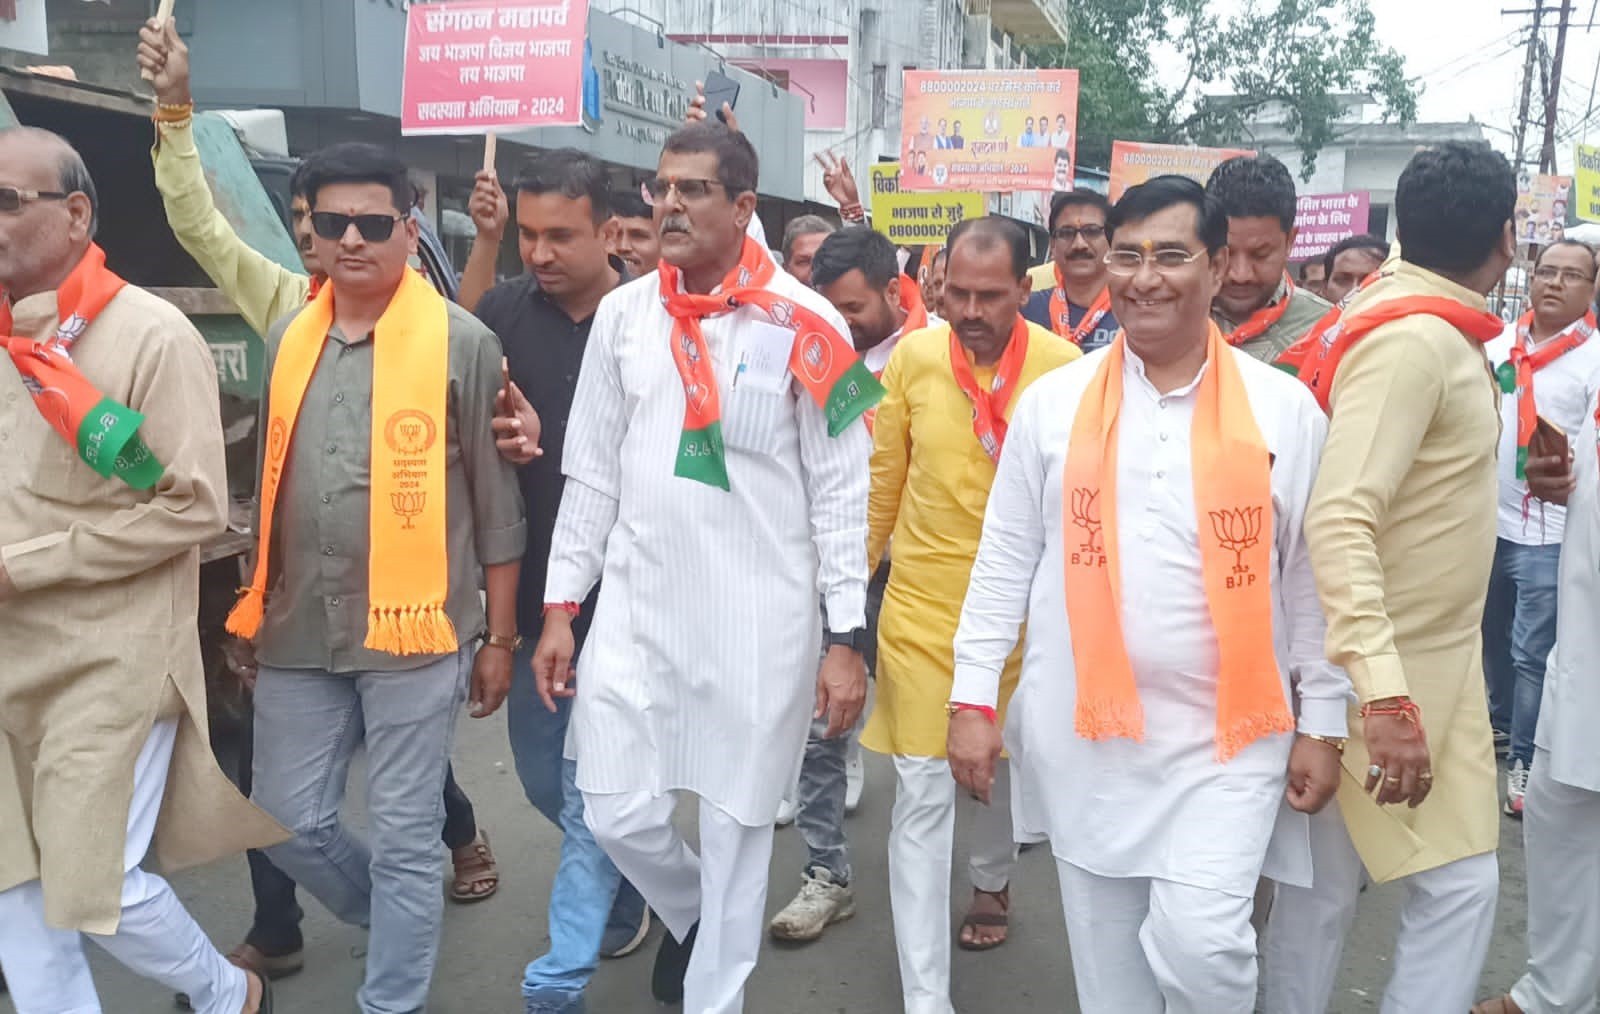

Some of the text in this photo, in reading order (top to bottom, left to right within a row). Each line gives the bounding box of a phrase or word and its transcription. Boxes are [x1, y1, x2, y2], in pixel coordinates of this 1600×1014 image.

[425, 1, 569, 32] संगठन महापर्व
[418, 36, 572, 63] जय भाजपा विजय भाजपा
[460, 64, 526, 84] तय भाजपा
[919, 80, 986, 94] 8800002024
[417, 101, 466, 121] सदस्यता
[468, 95, 520, 119] अभियान
[531, 97, 565, 116] 2024
[1322, 197, 1347, 212] भारत
[1348, 192, 1360, 209] के
[892, 206, 928, 219] भाजपा
[931, 203, 943, 219] से
[1318, 211, 1328, 226] के
[1330, 210, 1352, 225] लिए
[392, 469, 427, 480] अभियान
[399, 481, 419, 489] 2024
[1071, 553, 1107, 568] BJP
[1226, 574, 1256, 589] BJP
